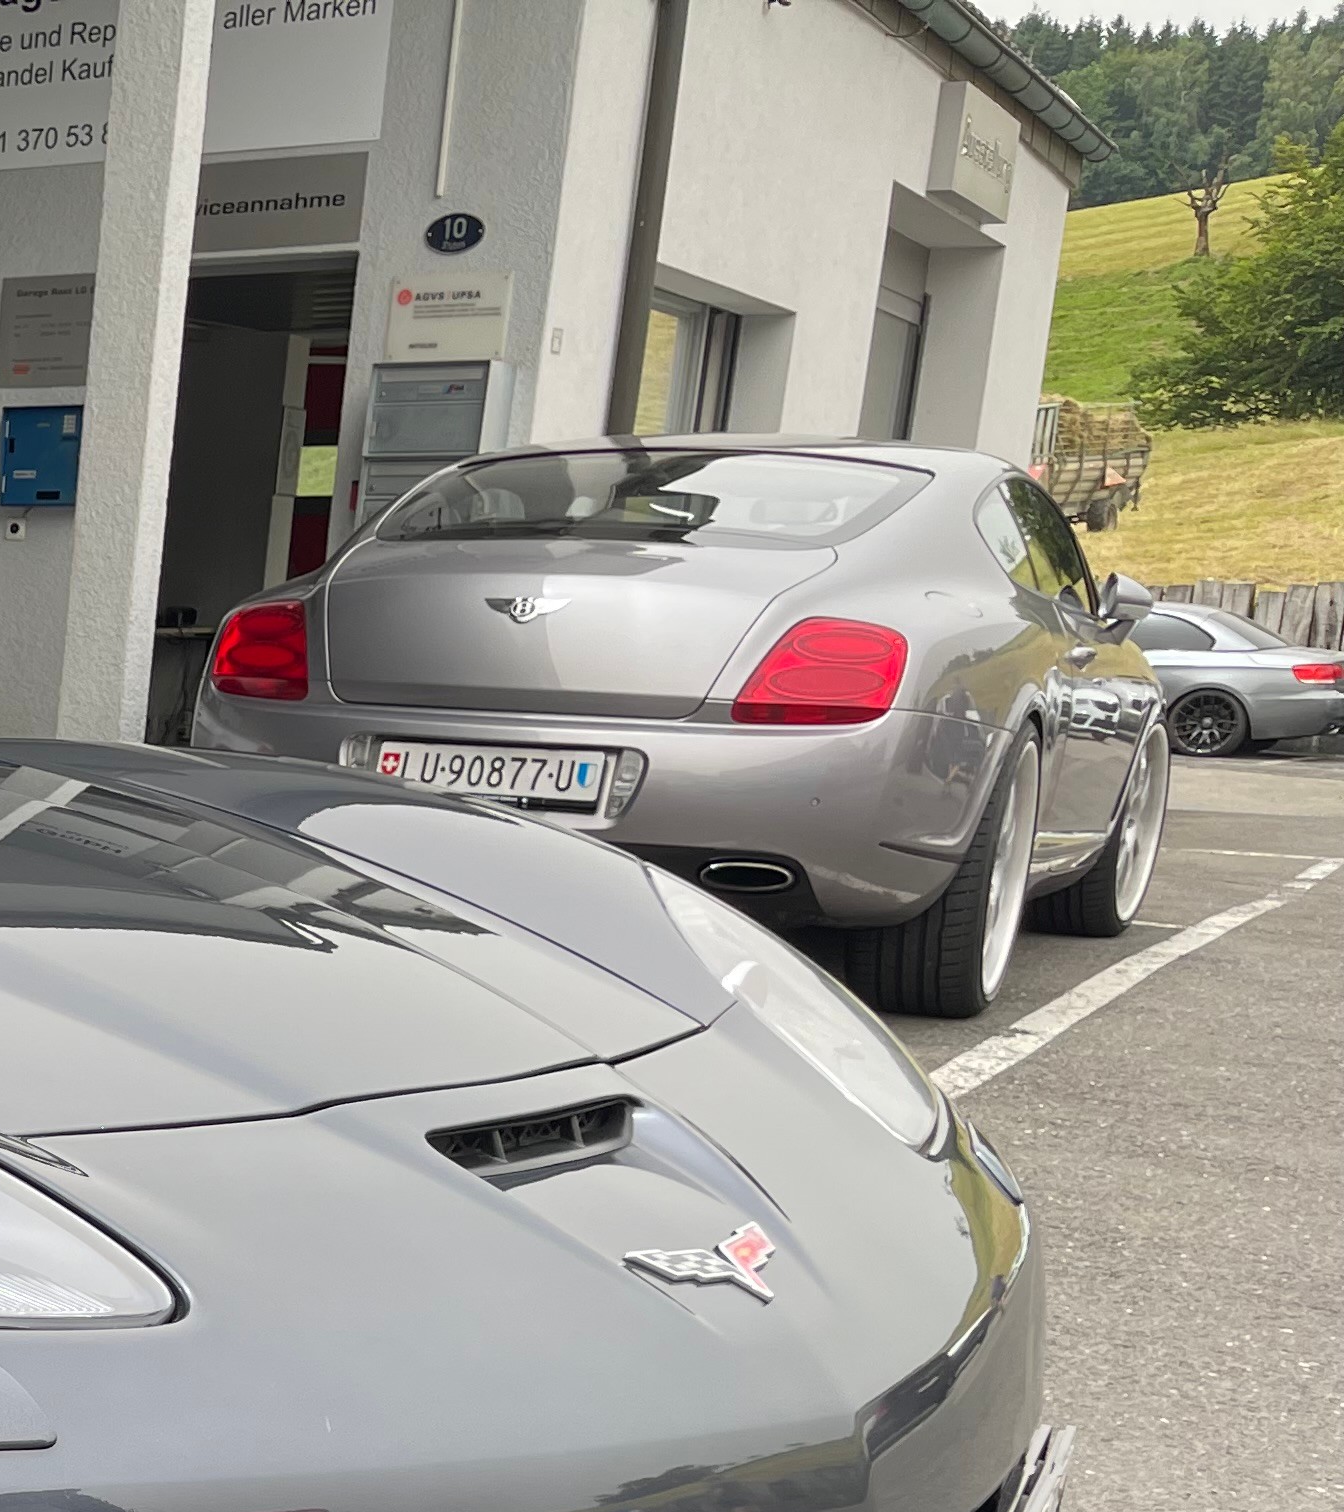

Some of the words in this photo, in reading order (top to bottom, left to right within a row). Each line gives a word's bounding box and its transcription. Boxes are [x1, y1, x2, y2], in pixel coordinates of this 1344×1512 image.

[223, 4, 277, 30] aller
[283, 0, 377, 24] Marken
[20, 24, 62, 51] und
[69, 21, 117, 46] Rep
[61, 55, 114, 82] Kauf
[16, 127, 59, 151] 370
[65, 123, 94, 148] 53
[443, 216, 469, 241] 10
[414, 291, 445, 301] AGVS
